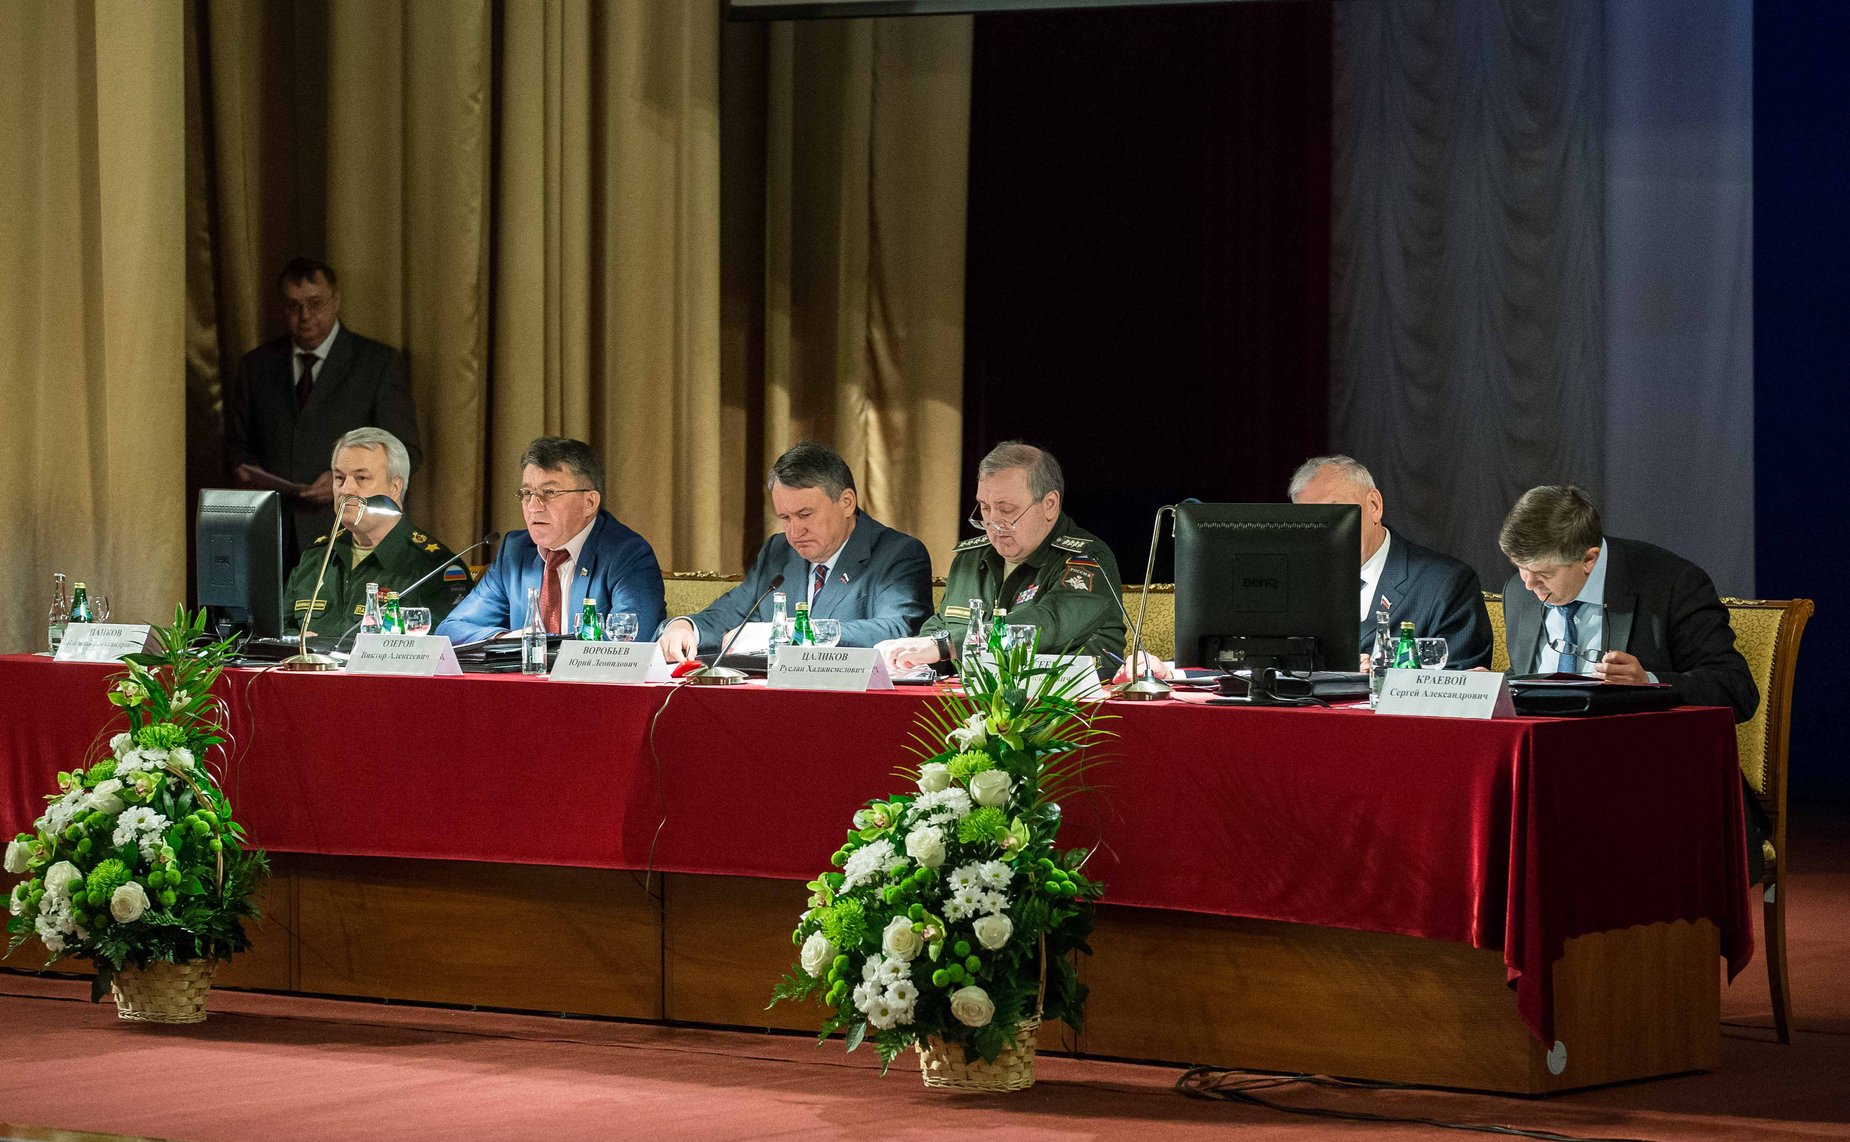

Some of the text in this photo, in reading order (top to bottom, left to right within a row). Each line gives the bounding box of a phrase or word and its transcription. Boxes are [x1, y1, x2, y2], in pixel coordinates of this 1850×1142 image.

[89, 628, 123, 637] ПАНКОВ
[382, 639, 416, 648] ОЗЕРОВ
[360, 651, 388, 661] Виктор
[389, 652, 431, 661] Алексеевич
[582, 646, 631, 656] ВОРОБЬЕВ
[801, 652, 849, 662] ЦАЛИКОВ
[568, 658, 639, 668] Юрий Леонидович
[779, 664, 805, 674] Руслан
[1415, 674, 1468, 686] КРАЕВОЙ
[1389, 687, 1489, 701] Сергей Александрович
